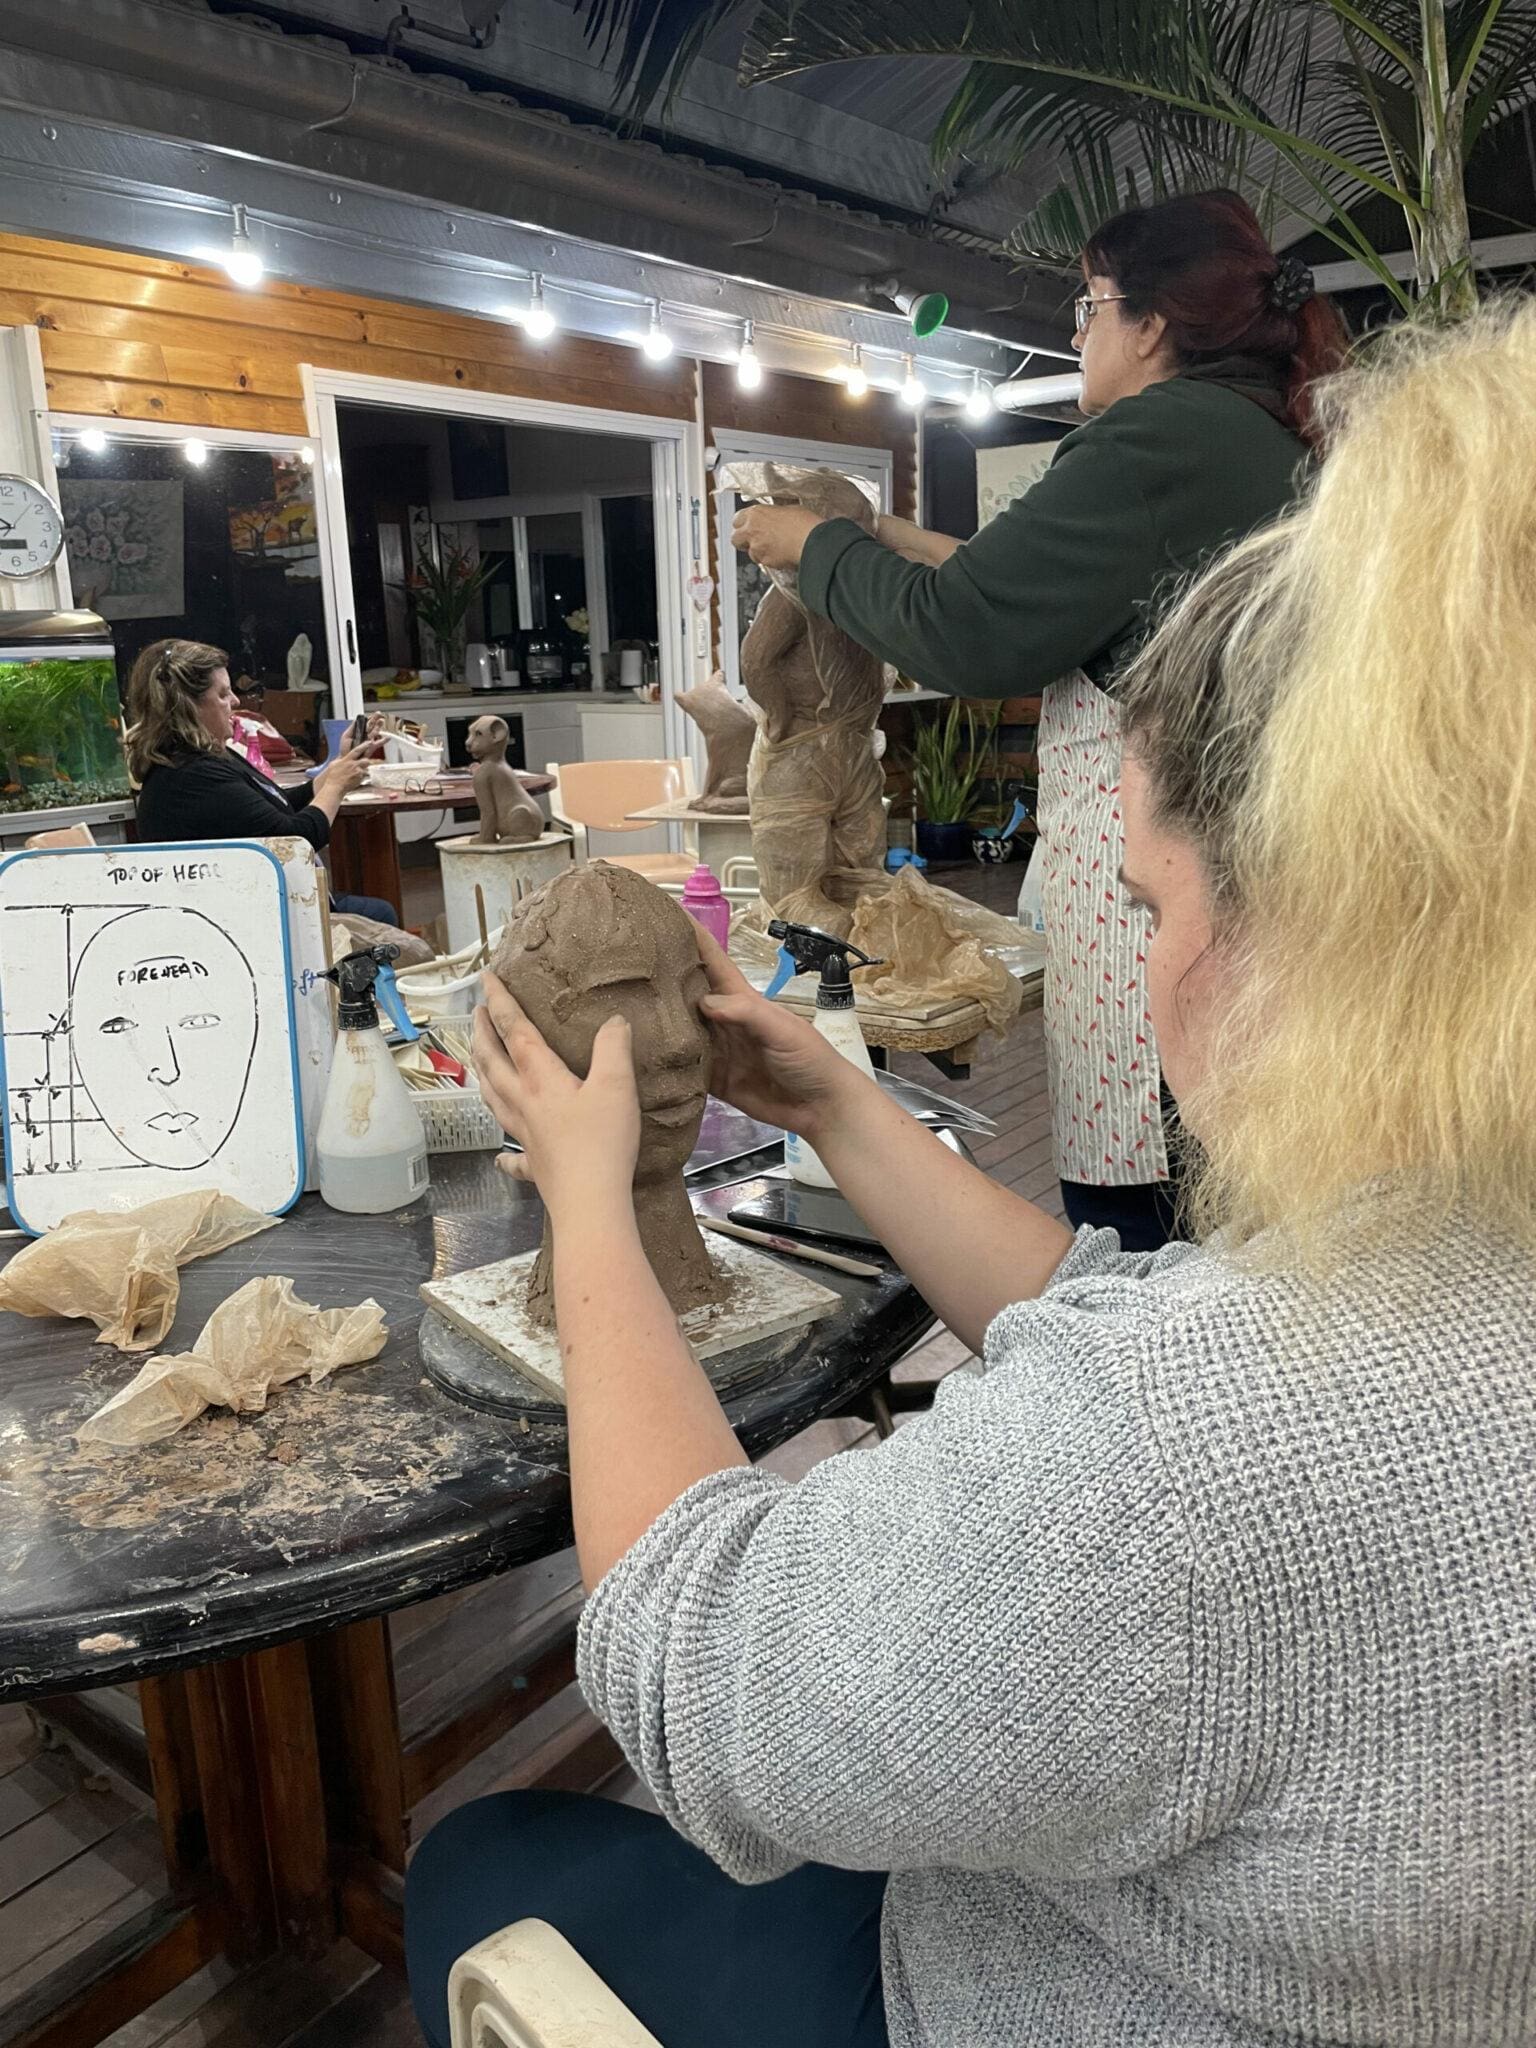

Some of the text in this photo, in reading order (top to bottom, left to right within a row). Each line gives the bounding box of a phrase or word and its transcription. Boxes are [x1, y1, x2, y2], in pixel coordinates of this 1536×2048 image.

[34, 504, 44, 515] 2
[42, 521, 52, 532] 3
[39, 539, 48, 549] 4
[11, 555, 22, 567] 6
[28, 550, 38, 562] 5
[142, 867, 163, 883] OF
[117, 960, 209, 986] FOREHEAD
